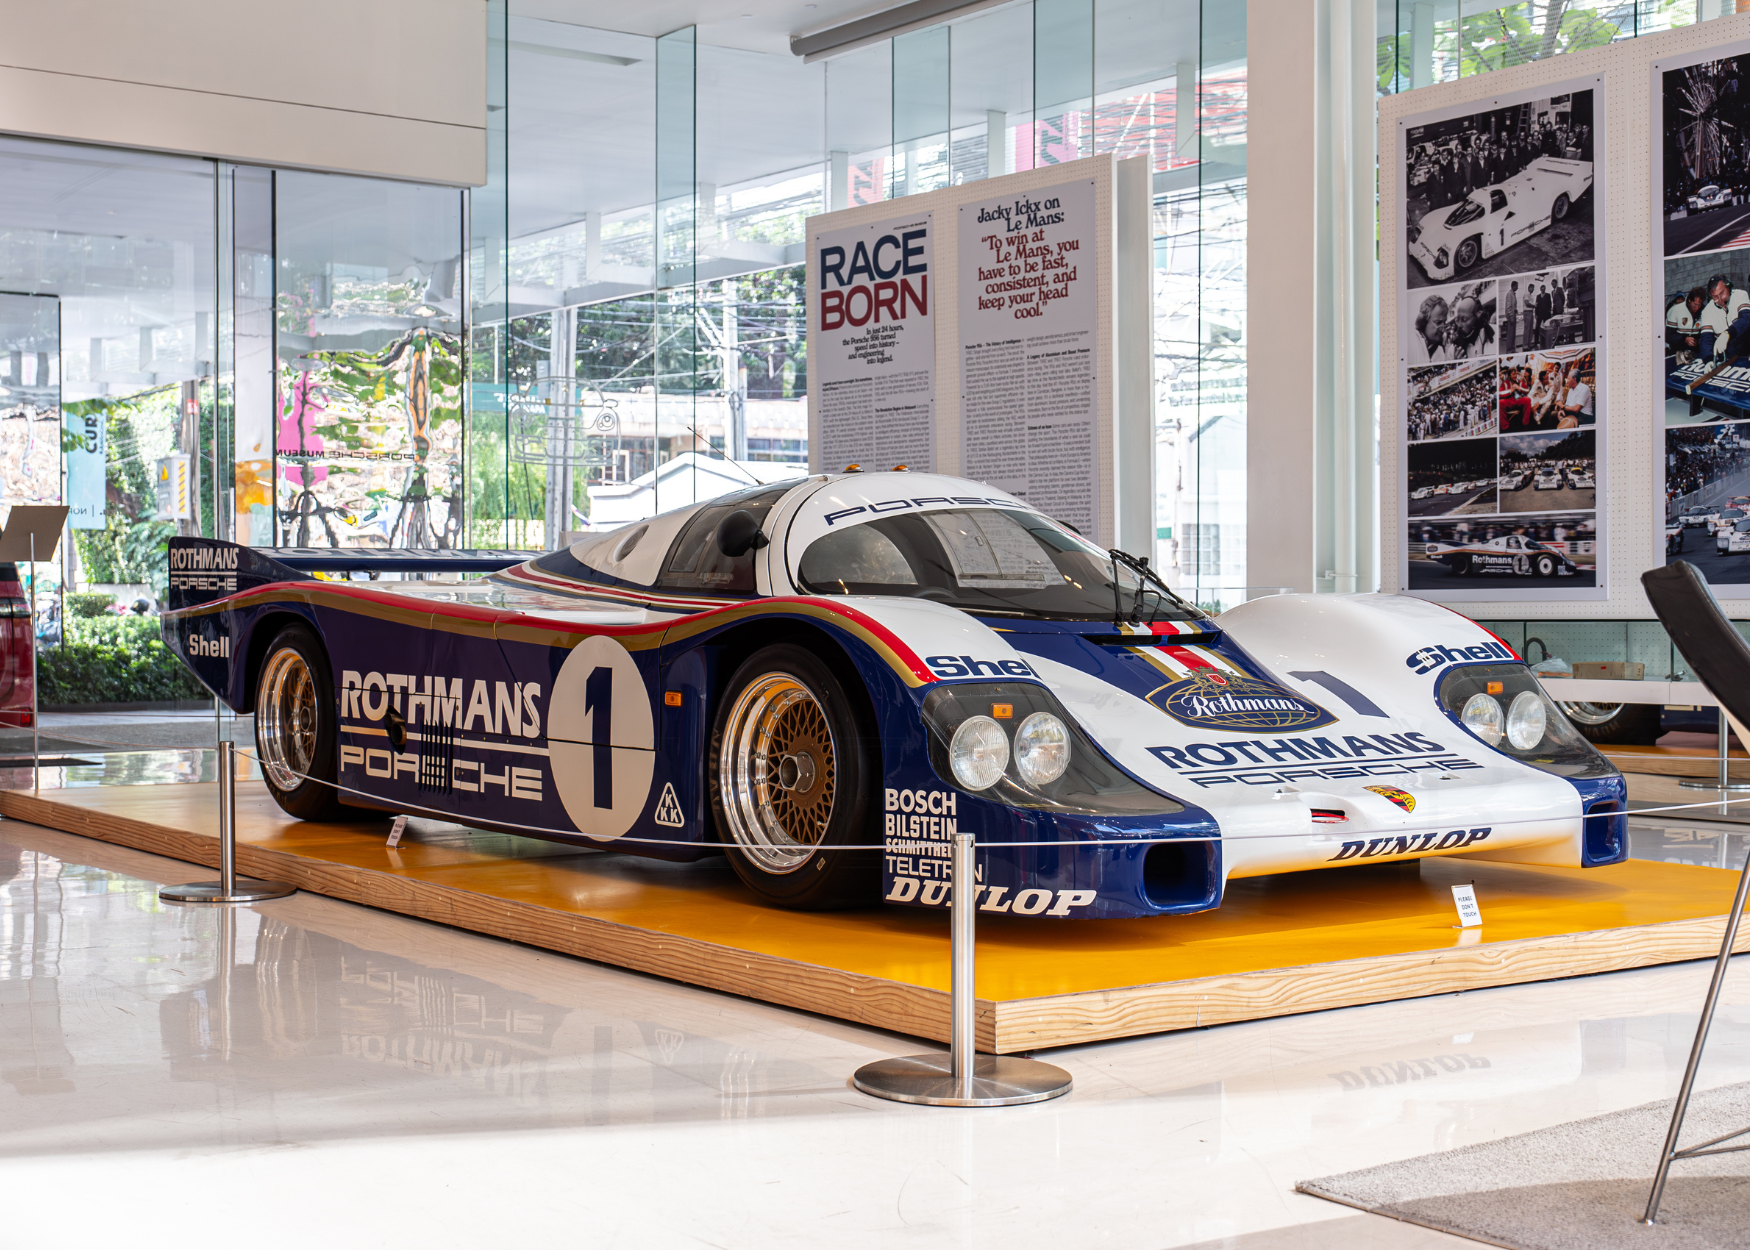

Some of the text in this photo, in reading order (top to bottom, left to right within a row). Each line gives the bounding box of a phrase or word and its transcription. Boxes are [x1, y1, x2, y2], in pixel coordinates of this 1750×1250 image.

[978, 197, 1060, 223] Jacky Ickx on
[1006, 212, 1064, 232] Le Mans:
[1006, 231, 1029, 246] win
[1032, 228, 1045, 242] at
[820, 228, 927, 290] RACE
[996, 239, 1079, 263] Le Mans, you
[978, 254, 1068, 281] have to be fast,
[986, 266, 1077, 294] consistent, and
[821, 274, 928, 332] BORN
[978, 283, 1068, 310] keep your head
[1014, 300, 1047, 319] cool.”
[851, 336, 869, 344] Porsche
[881, 332, 896, 340] turned
[855, 343, 868, 352] speed
[858, 349, 885, 359] engineering
[877, 354, 893, 364] legend.
[170, 548, 239, 569] ROTHMANS
[1472, 555, 1512, 564] Rothmans
[170, 577, 237, 591] PORSCHE
[189, 634, 230, 658] Shell
[1406, 642, 1514, 675] Shell
[341, 670, 541, 738] ROTHMANS
[1181, 693, 1314, 717] Rothmans
[1287, 671, 1390, 718] 1
[585, 666, 612, 810] 1
[1145, 732, 1445, 769] ROTHMANS
[1188, 759, 1485, 788] PORSCHE
[885, 788, 957, 815] BOSCH
[885, 814, 957, 840] BILSTEIN
[1327, 828, 1492, 862] DUNLOP
[885, 855, 982, 882] TELETRN
